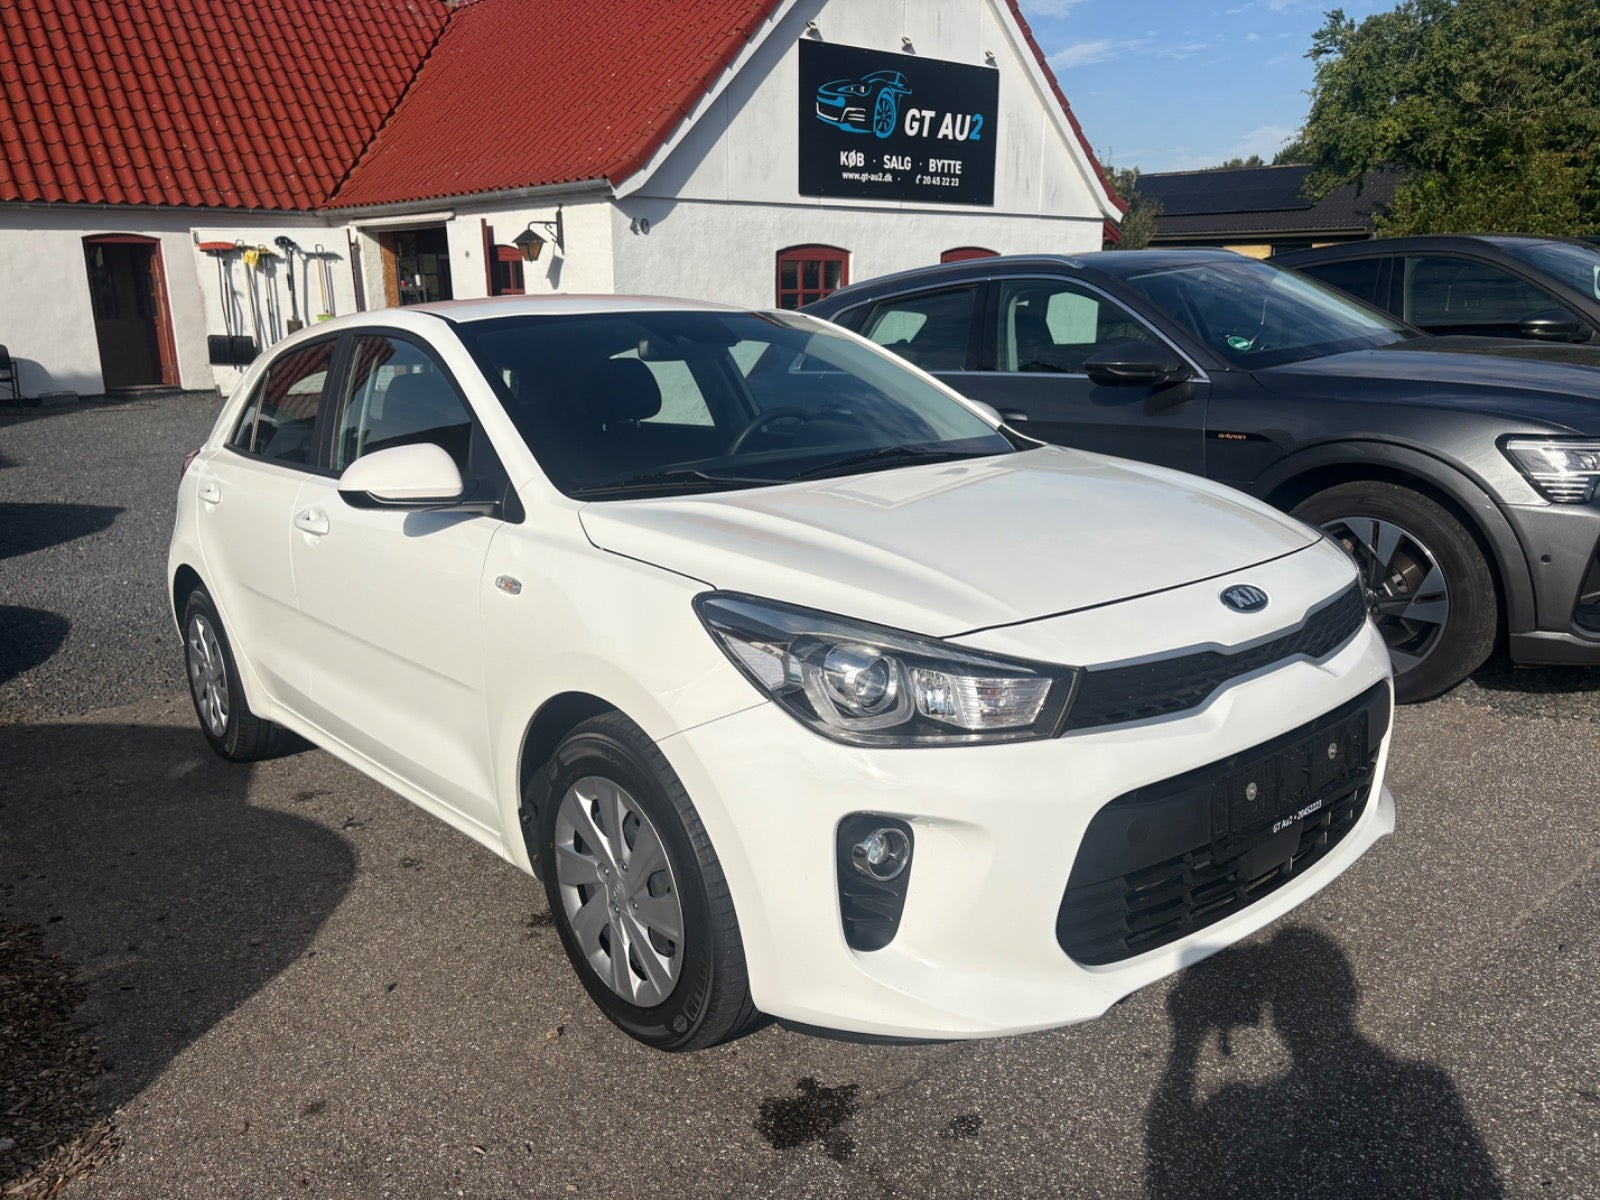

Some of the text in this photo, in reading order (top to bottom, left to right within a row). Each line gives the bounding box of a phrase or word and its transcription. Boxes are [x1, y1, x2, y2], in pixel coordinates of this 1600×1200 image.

[904, 108, 984, 142] GT AU2
[839, 150, 962, 174] KØB SALG BYTTE
[842, 171, 959, 187] www.gt-au2.dk 20 45 22 23
[1272, 799, 1322, 833] GT Au2 20452223
